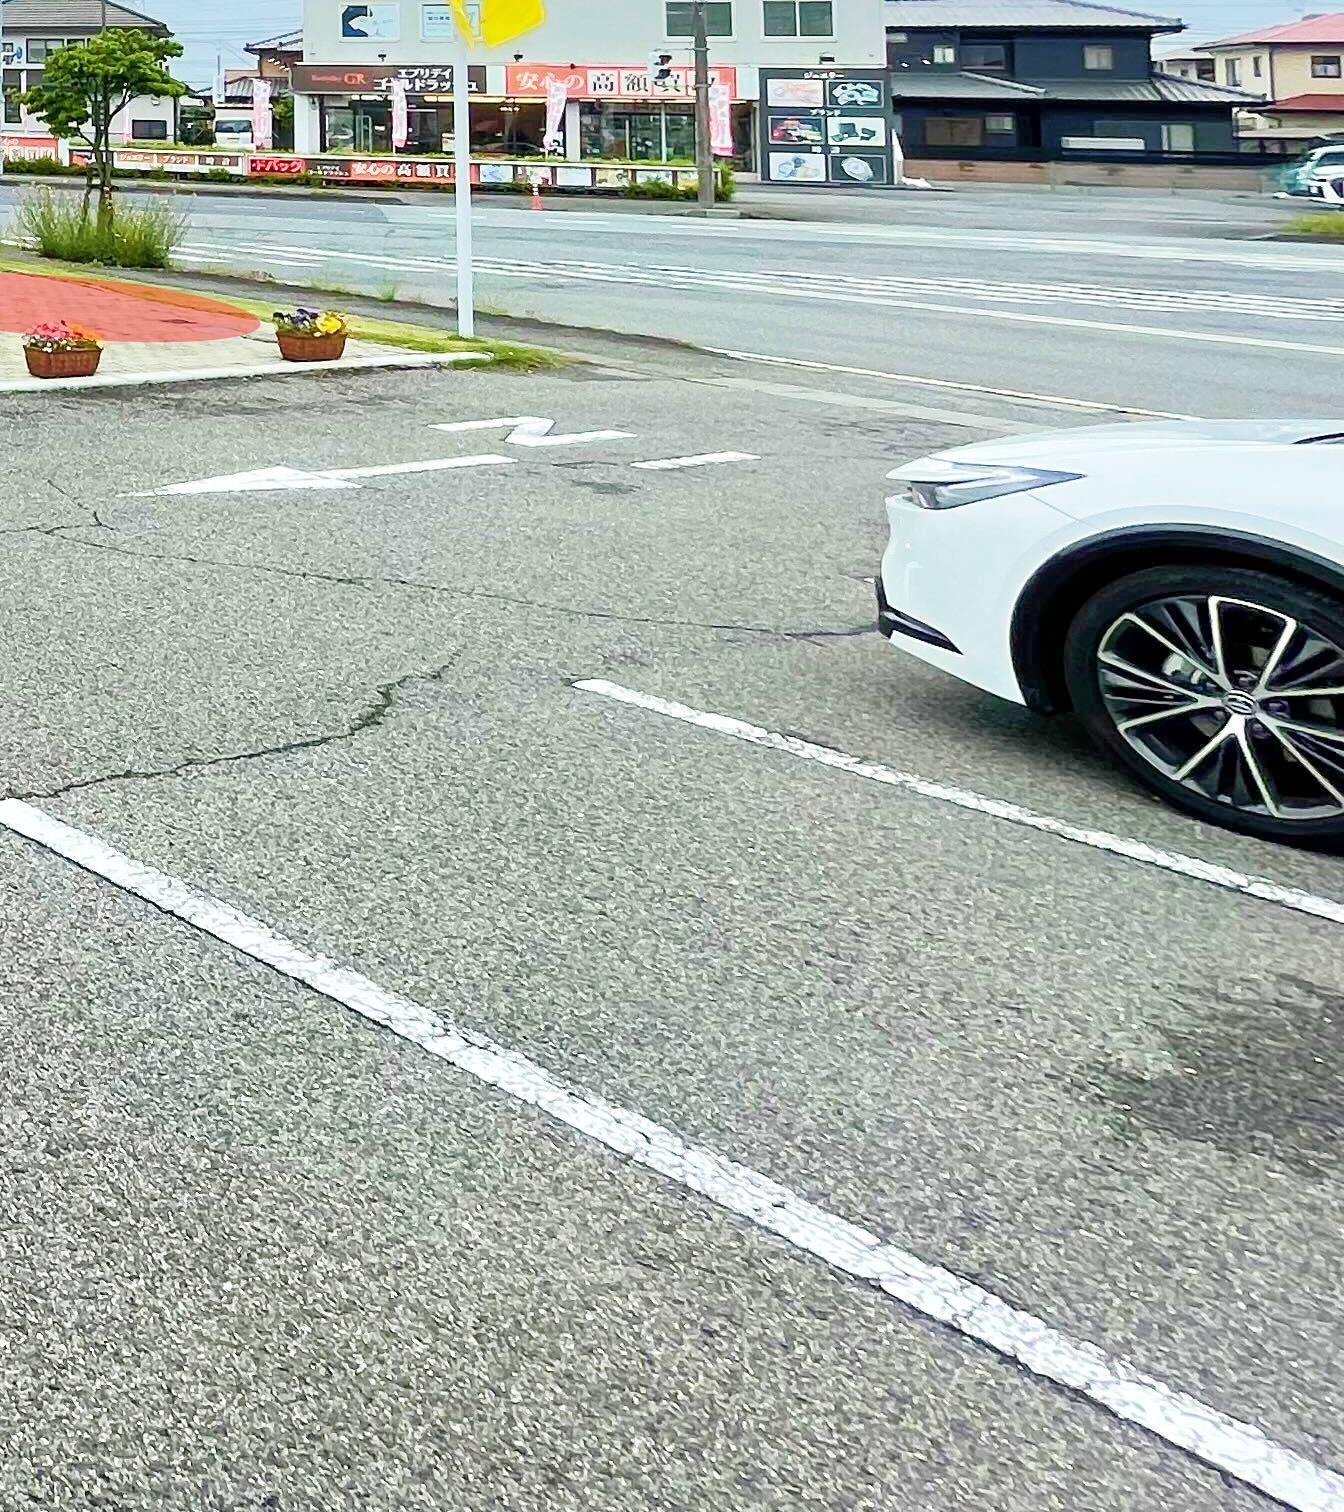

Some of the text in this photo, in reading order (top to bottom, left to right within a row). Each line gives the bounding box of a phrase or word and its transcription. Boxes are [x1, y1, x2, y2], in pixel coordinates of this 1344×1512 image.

[398, 68, 452, 79] エブリデイ
